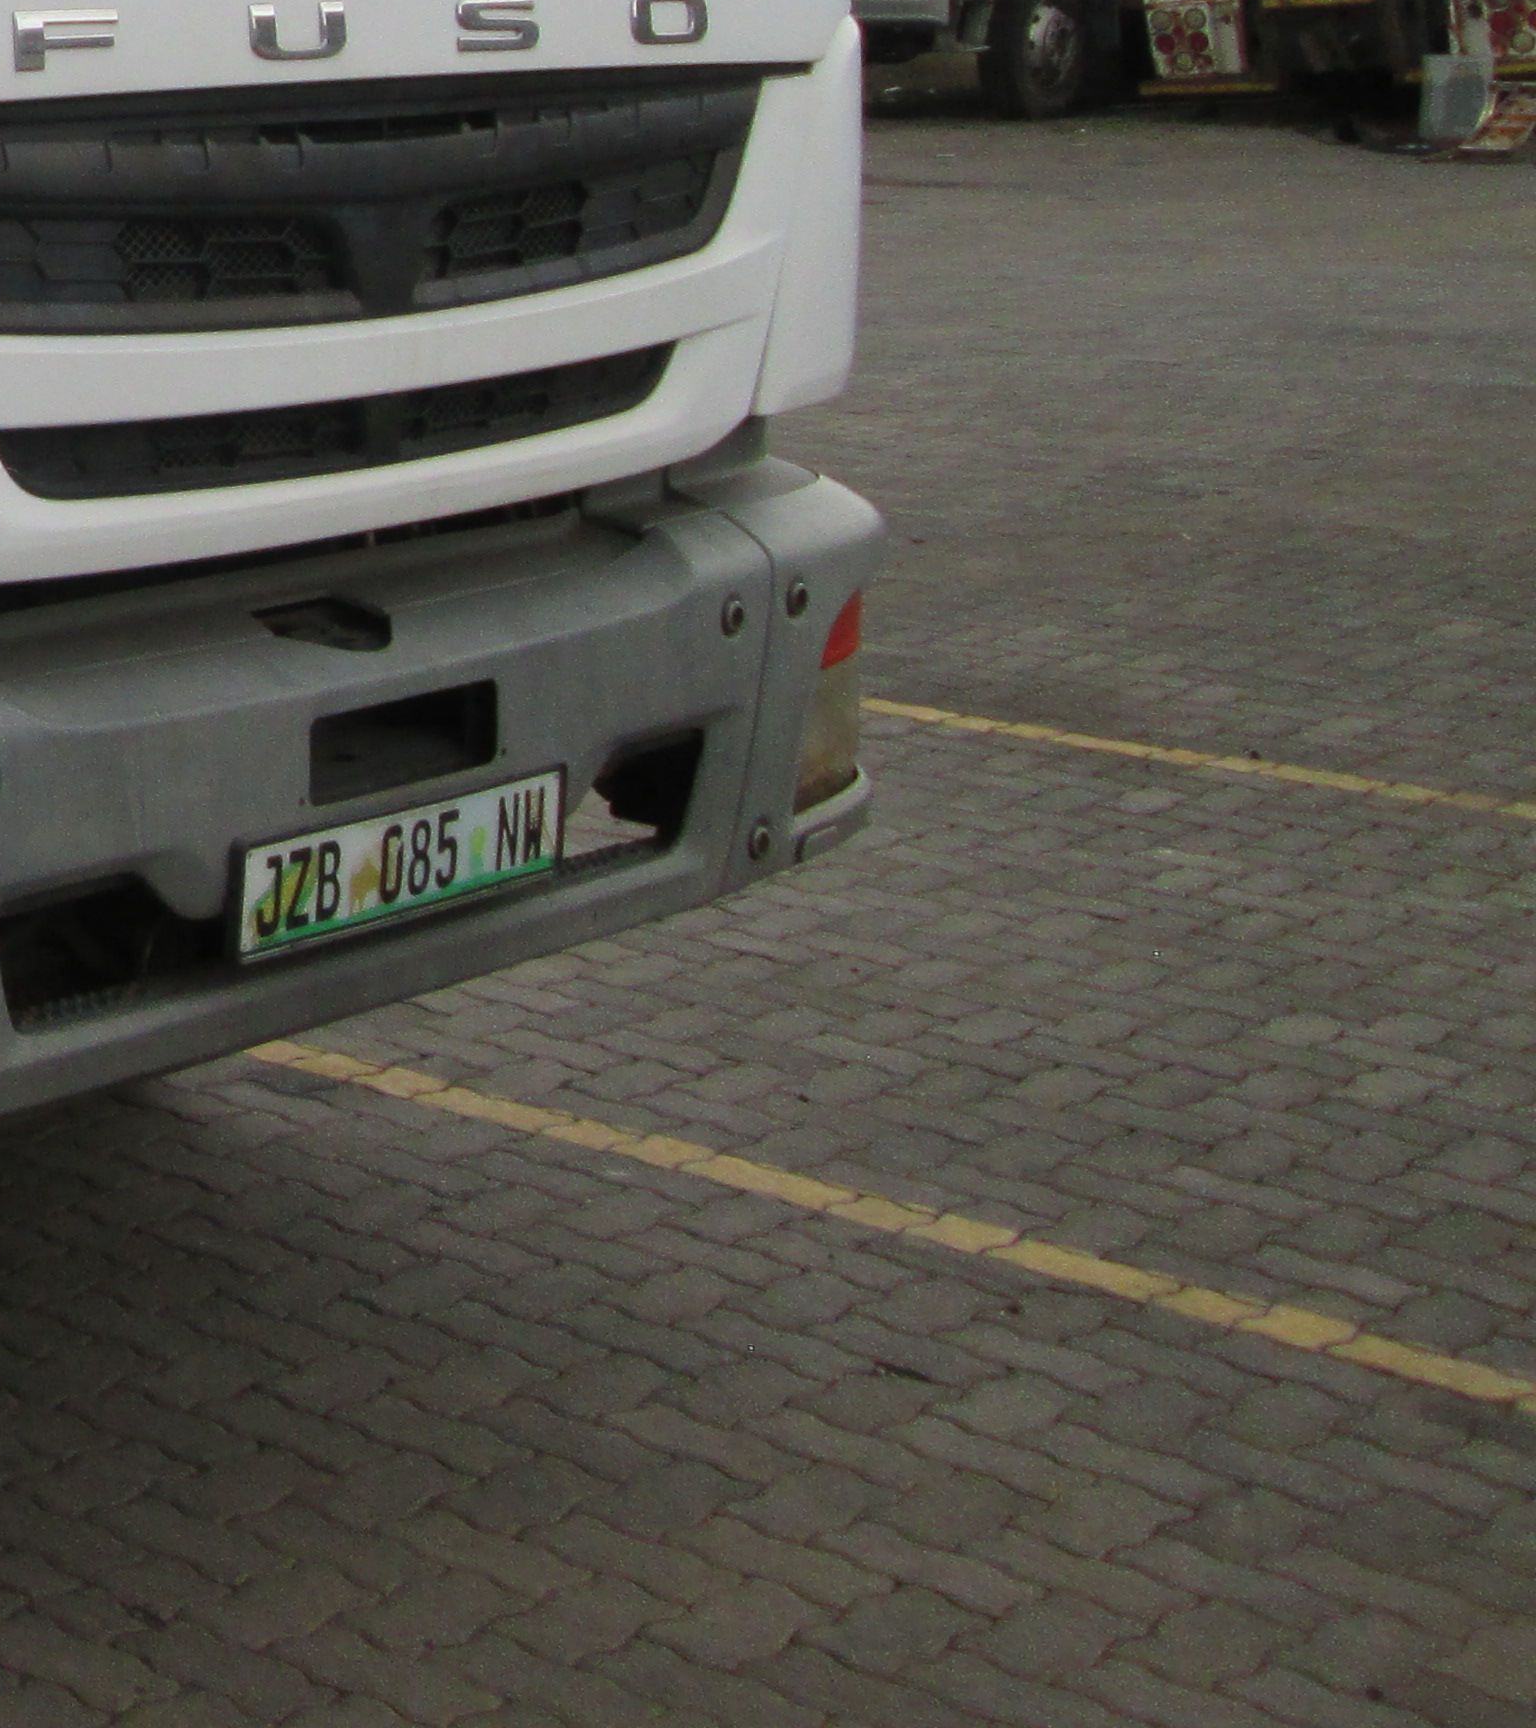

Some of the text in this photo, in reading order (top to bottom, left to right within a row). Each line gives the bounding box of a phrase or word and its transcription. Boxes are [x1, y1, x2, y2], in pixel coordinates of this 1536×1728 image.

[255, 786, 546, 937] JZB 085 NW
